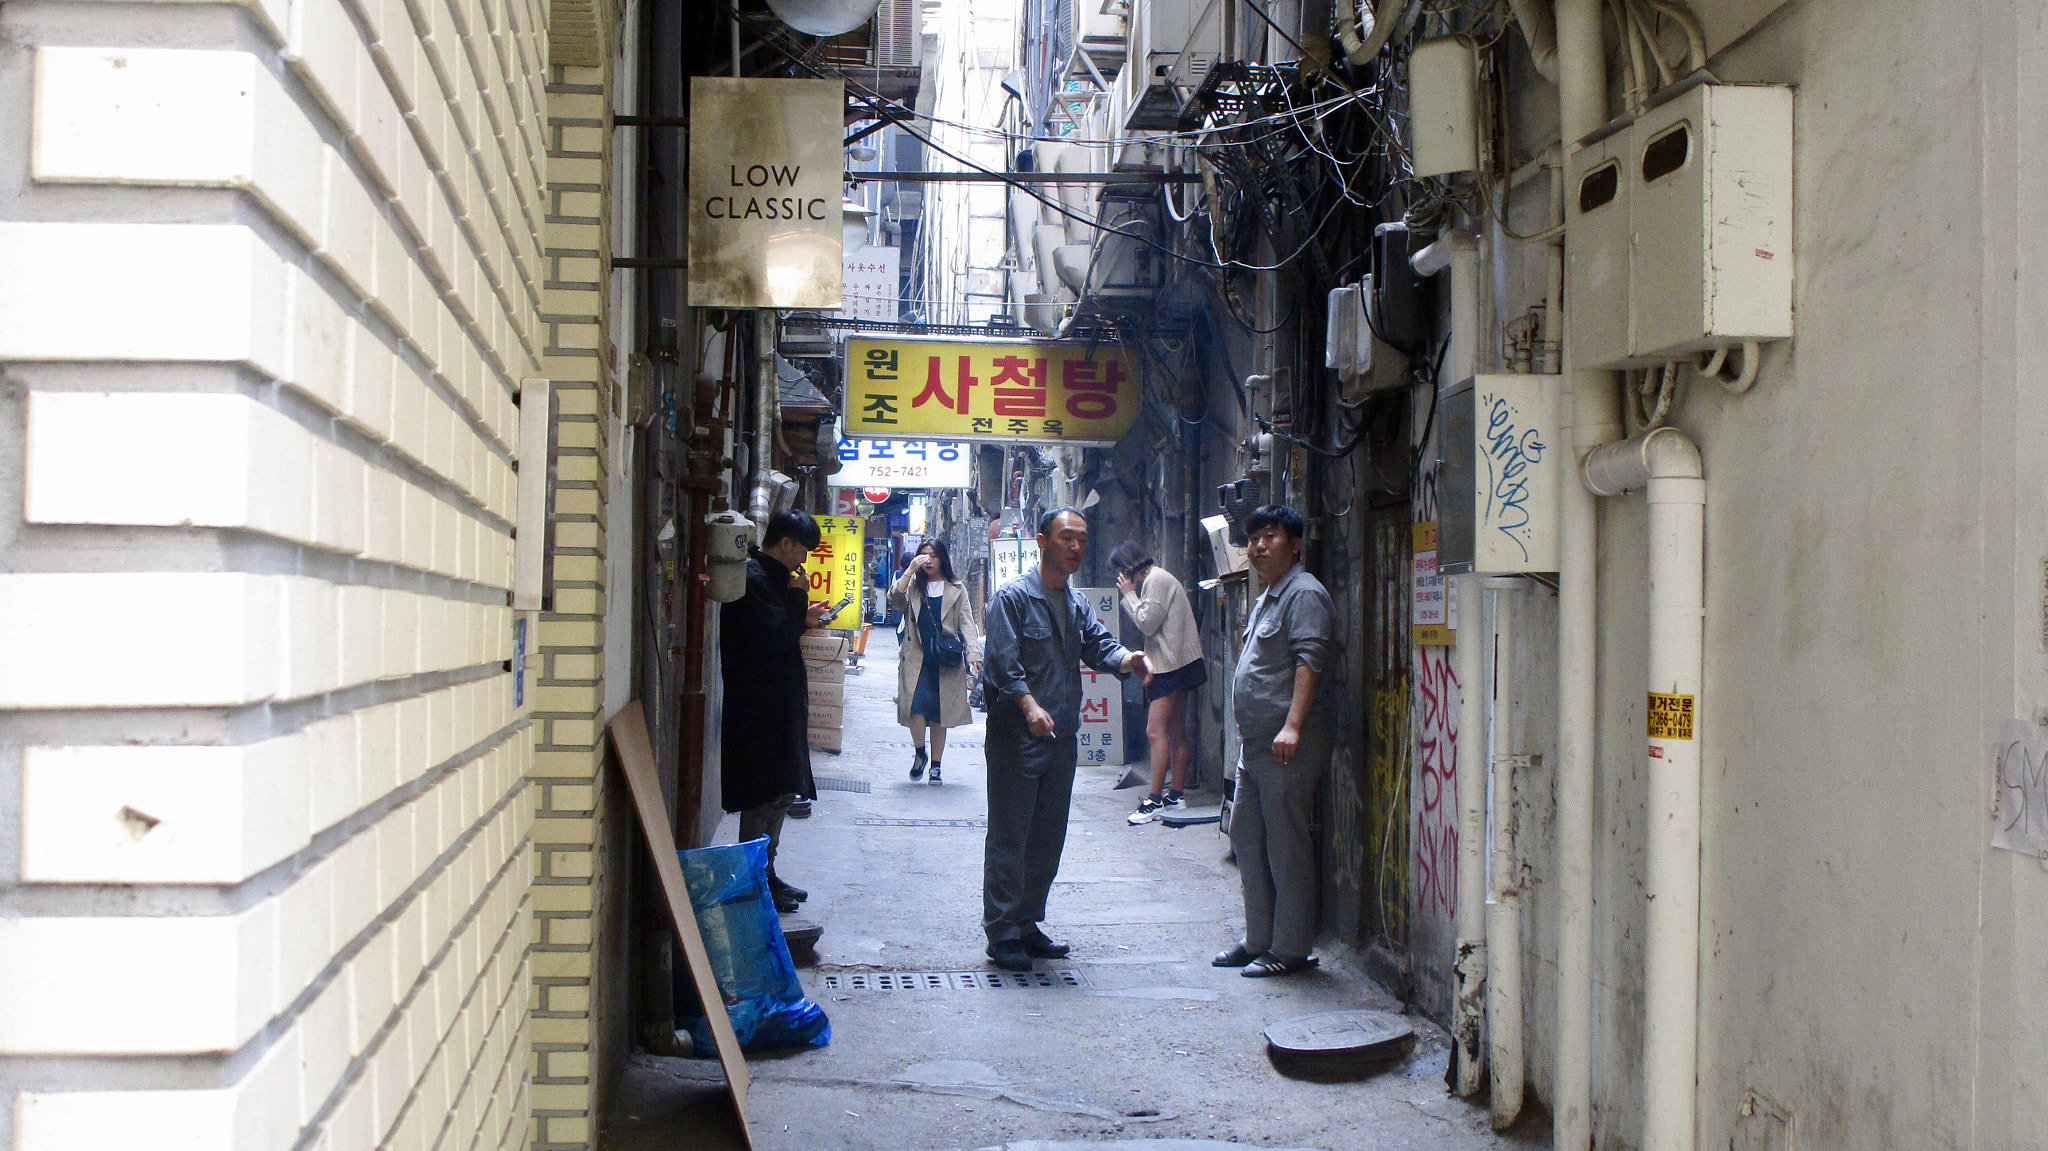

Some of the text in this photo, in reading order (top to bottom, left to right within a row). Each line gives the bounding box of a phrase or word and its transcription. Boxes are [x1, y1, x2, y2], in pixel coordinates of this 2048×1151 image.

[731, 164, 800, 187] LOW
[705, 196, 826, 220] CLASSIC
[841, 262, 886, 273] 사옷수선
[862, 348, 899, 425] 원조
[911, 354, 1127, 420] 사철탕
[971, 416, 1064, 436] 전주옥
[869, 466, 928, 477] 752-7421
[1079, 733, 1113, 746] 전문
[1086, 749, 1107, 762] 3층
